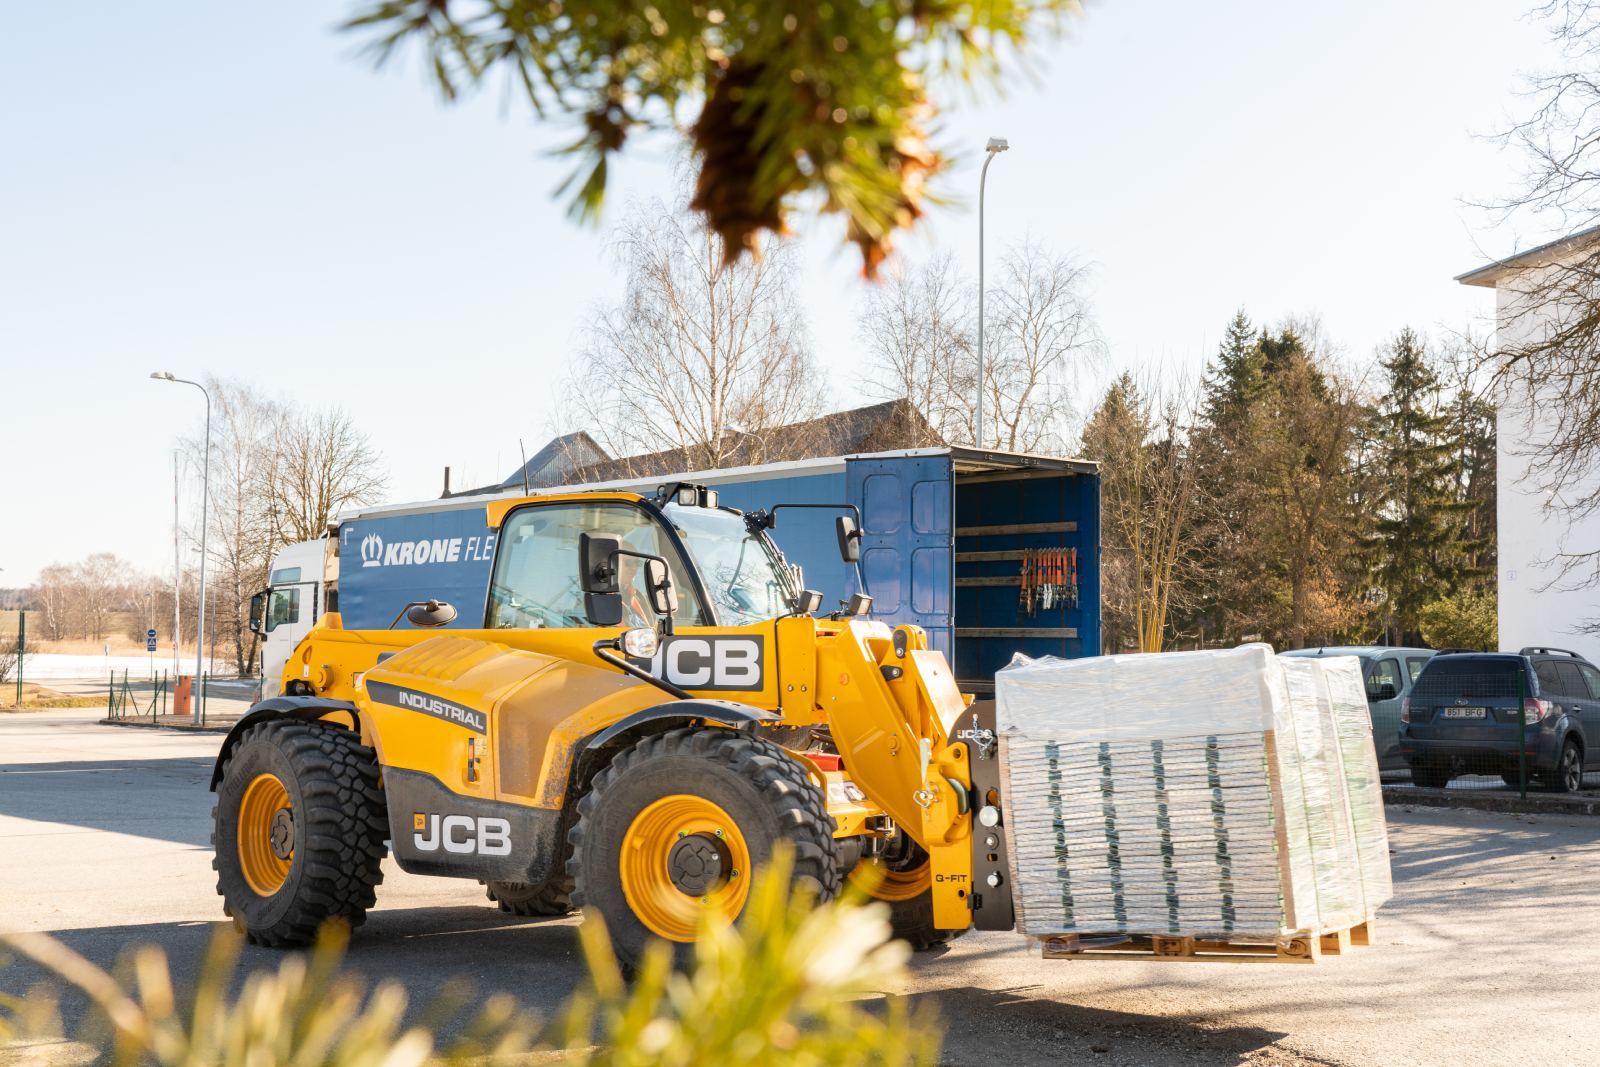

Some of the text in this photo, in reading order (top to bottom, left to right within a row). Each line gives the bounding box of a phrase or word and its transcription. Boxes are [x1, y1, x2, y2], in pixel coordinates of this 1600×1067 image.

[383, 535, 495, 566] KRONE FLE
[399, 691, 484, 730] INDUSTRIAL
[413, 814, 512, 856] JCB
[935, 874, 968, 883] Q-FIT
